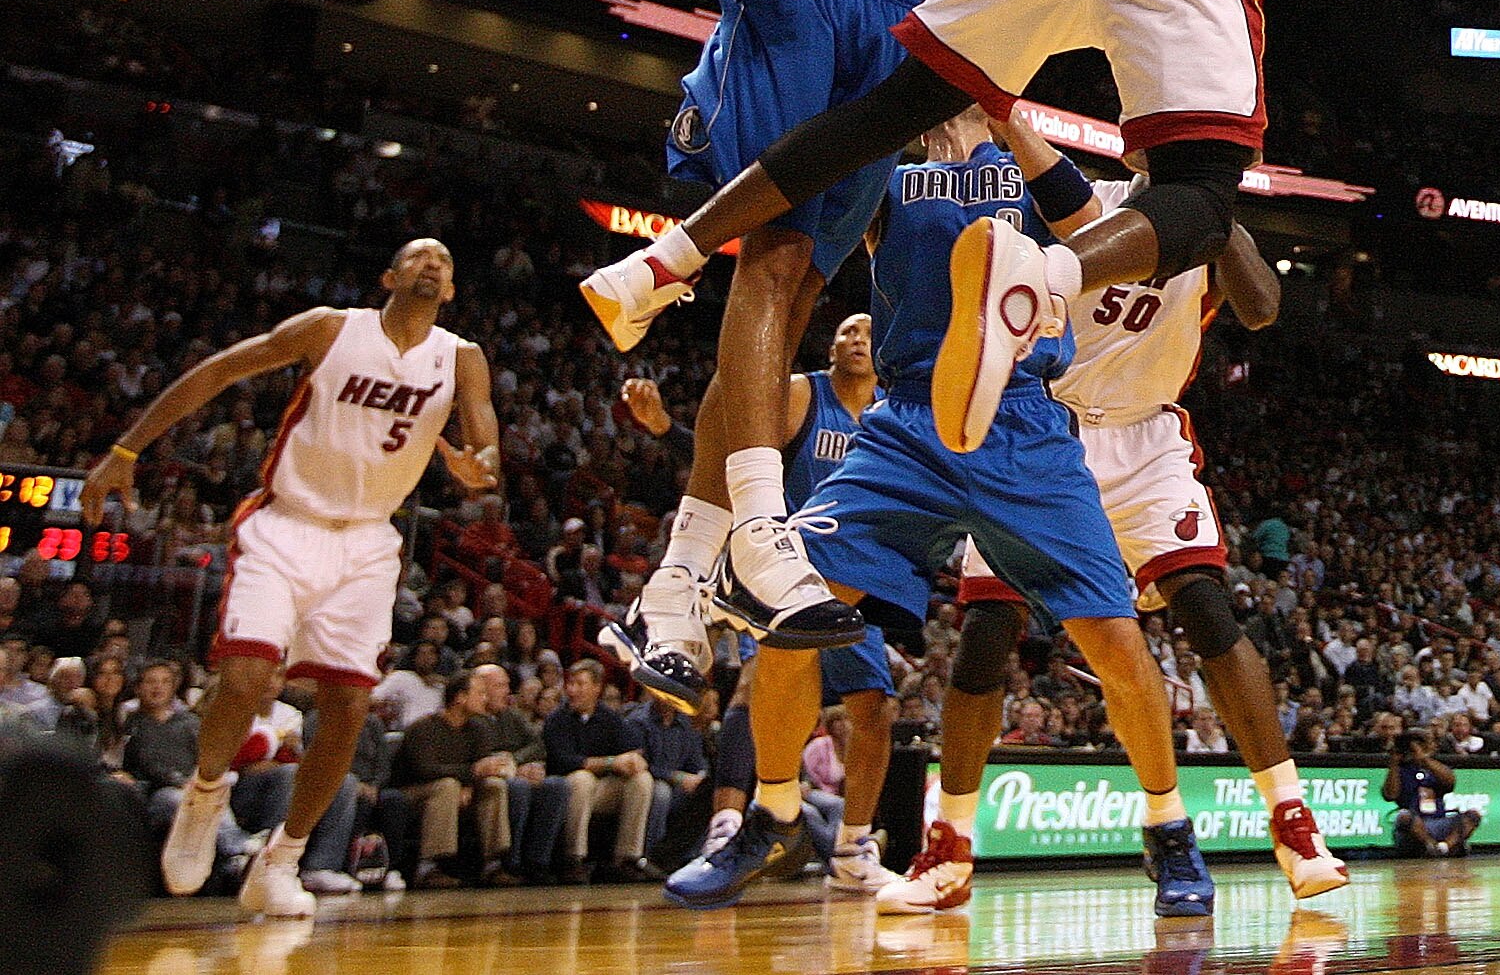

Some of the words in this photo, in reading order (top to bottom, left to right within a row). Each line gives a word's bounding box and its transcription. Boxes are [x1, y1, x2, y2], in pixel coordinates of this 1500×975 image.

[1029, 110, 1081, 142] Value
[902, 164, 1024, 216] DALLAS
[1092, 285, 1164, 333] 50
[337, 374, 443, 417] HEAT
[381, 418, 414, 453] 5
[1213, 778, 1256, 805] THE
[1310, 778, 1368, 805] TASTE
[1198, 810, 1227, 840] OF
[1229, 810, 1268, 839] THE
